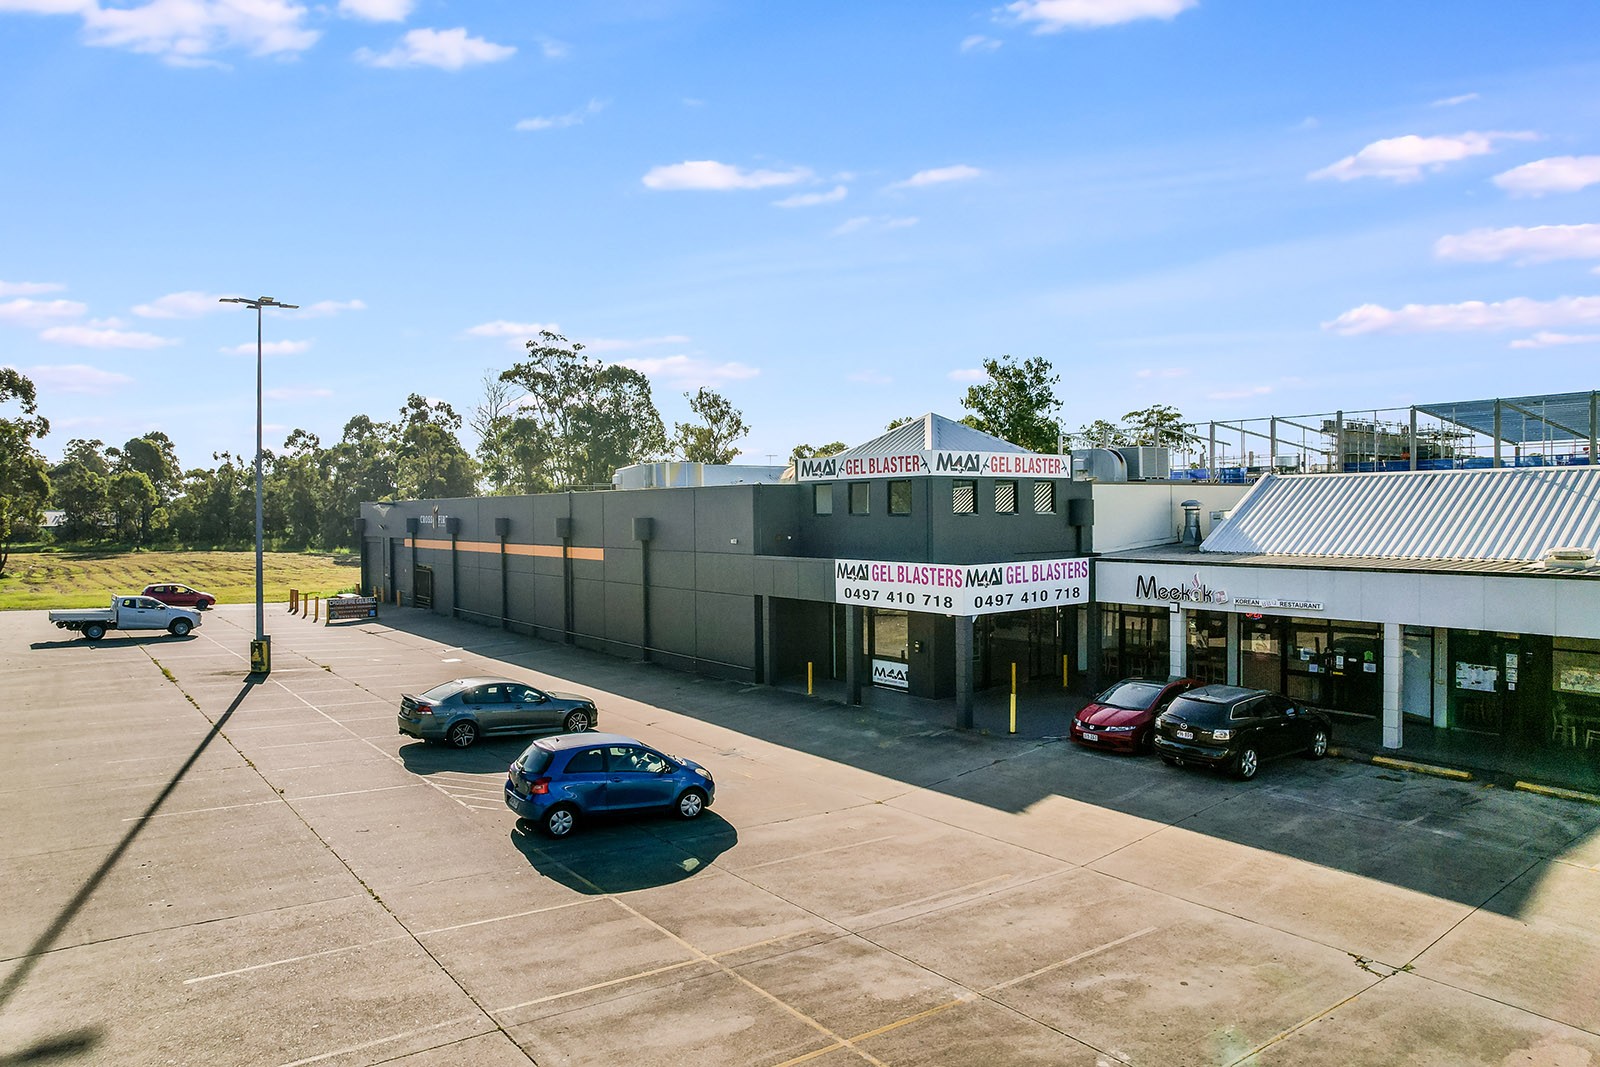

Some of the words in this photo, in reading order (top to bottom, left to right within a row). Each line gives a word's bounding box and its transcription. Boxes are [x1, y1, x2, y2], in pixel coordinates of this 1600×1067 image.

[845, 458, 867, 475] GEL
[869, 455, 920, 474] BLASTER
[990, 456, 1012, 473] GEL
[1014, 456, 1061, 474] BLASTER
[871, 564, 895, 583] GEL
[897, 565, 963, 589] BLASTERS
[1006, 565, 1029, 585] GEL
[1031, 560, 1088, 582] BLASTERS
[844, 586, 879, 602] 0497
[886, 590, 915, 605] 410
[922, 594, 953, 609] 718
[974, 594, 1014, 609] 0497
[1020, 589, 1048, 604] 410
[1054, 586, 1081, 600] 718
[1279, 601, 1321, 609] RESTAURANT
